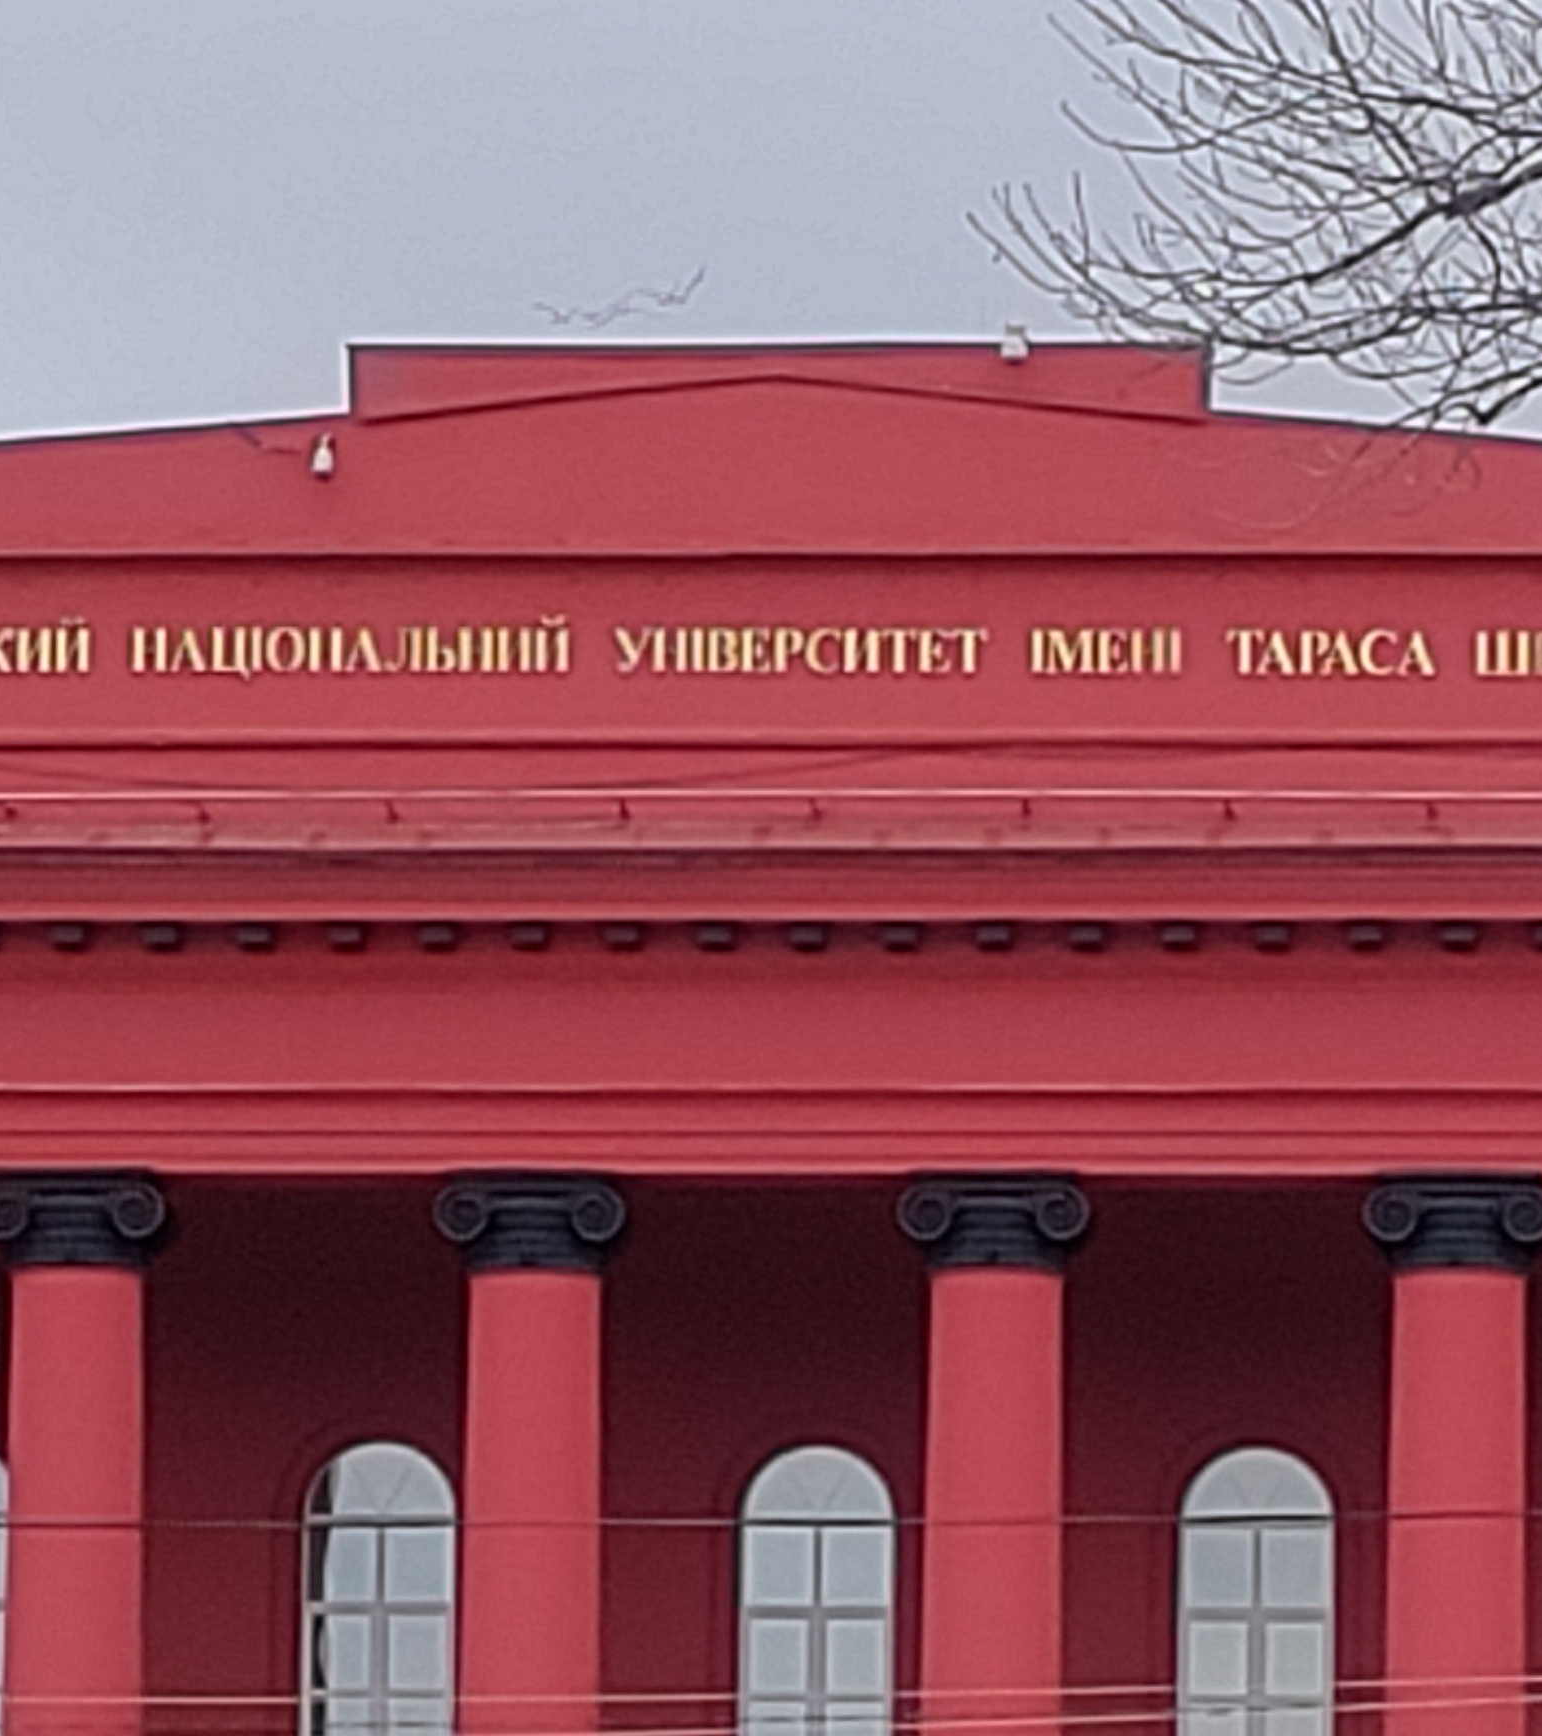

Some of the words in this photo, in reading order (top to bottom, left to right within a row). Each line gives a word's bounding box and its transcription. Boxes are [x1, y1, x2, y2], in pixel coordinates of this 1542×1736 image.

[131, 614, 571, 680] НАЦІОНАЛЬНИЙ
[614, 626, 990, 675] УНІВЕРСИТЕТ
[1030, 627, 1183, 675] ІМЕНІ
[1225, 628, 1436, 677] ТАРАСА
